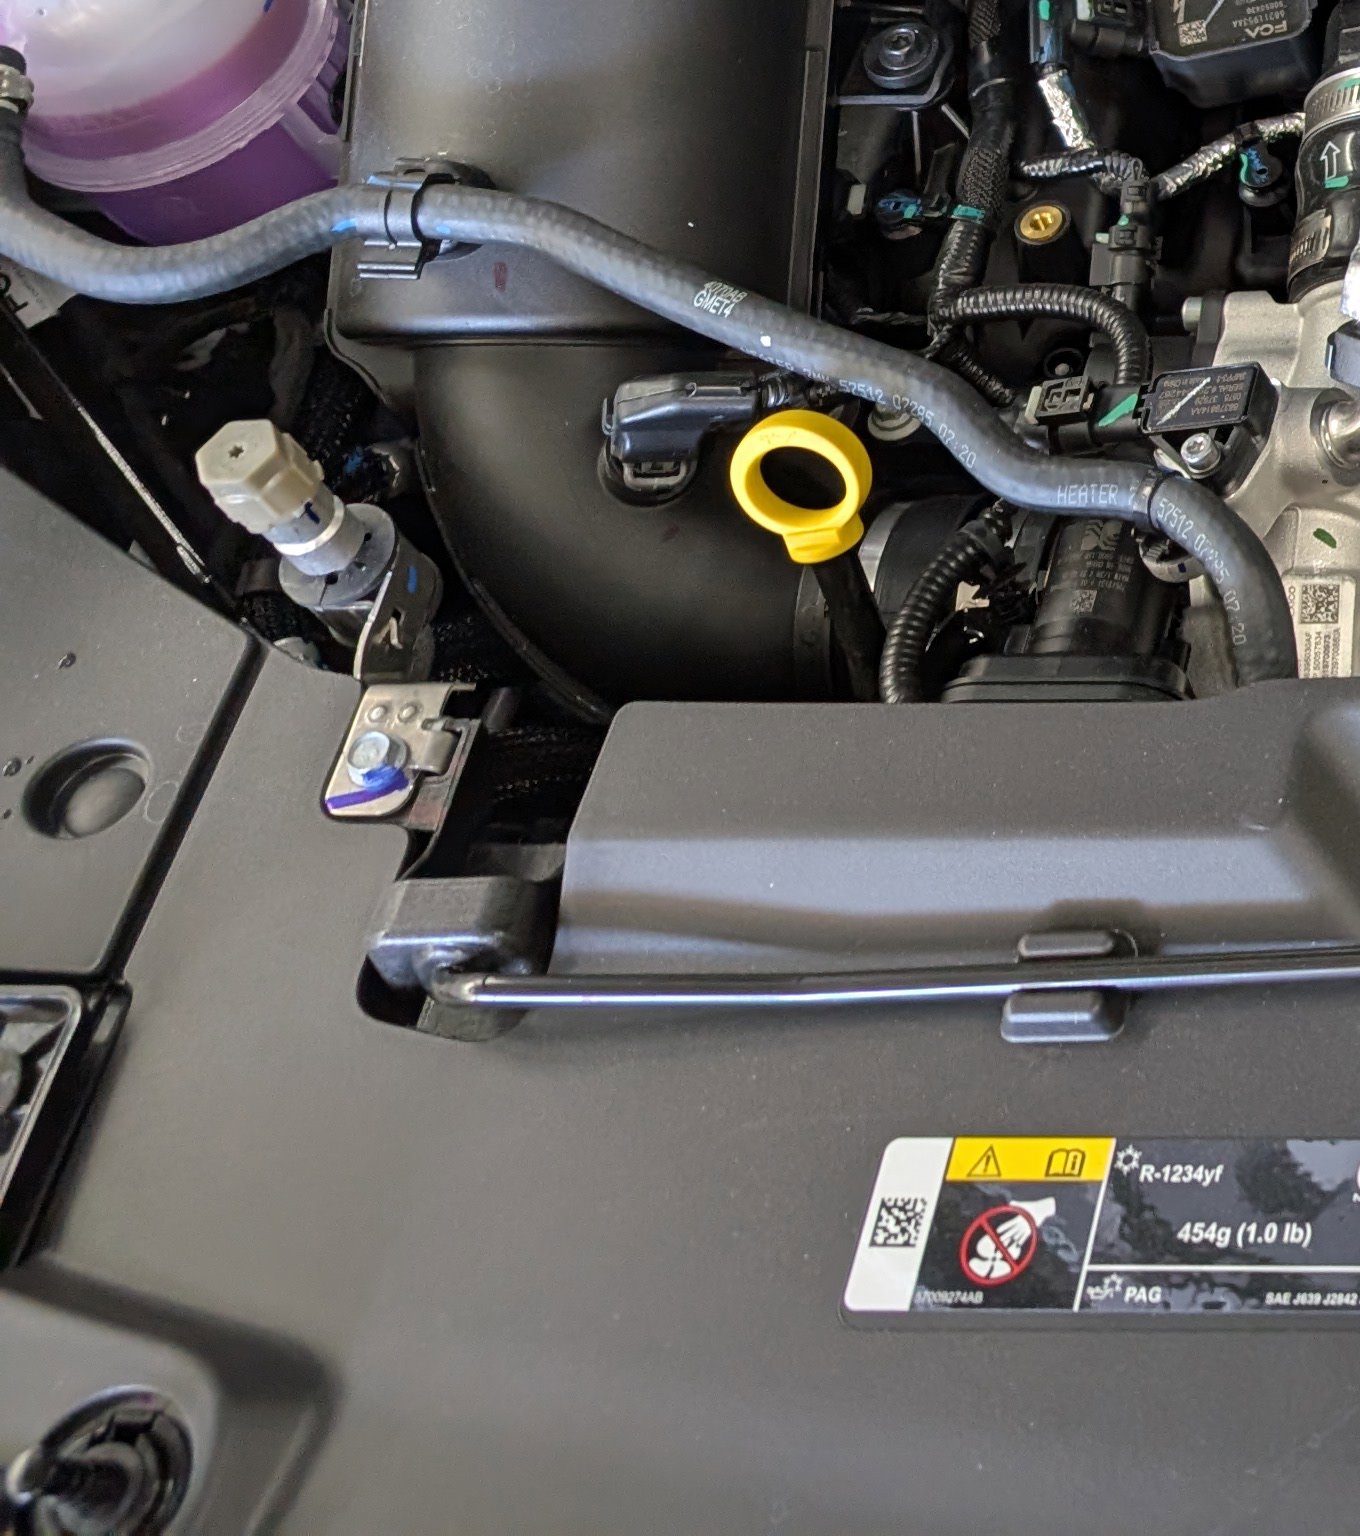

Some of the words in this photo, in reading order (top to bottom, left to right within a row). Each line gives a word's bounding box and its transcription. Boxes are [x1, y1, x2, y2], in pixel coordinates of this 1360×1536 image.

[1244, 18, 1287, 41] FCA
[1056, 484, 1119, 505] HEATER
[1139, 1163, 1224, 1186] R-1234yf
[1178, 1223, 1231, 1248] 454g
[1236, 1222, 1276, 1248] (1.0
[1282, 1222, 1312, 1248] lb)
[1125, 1285, 1162, 1303] PAG
[1265, 1292, 1291, 1306] SAE
